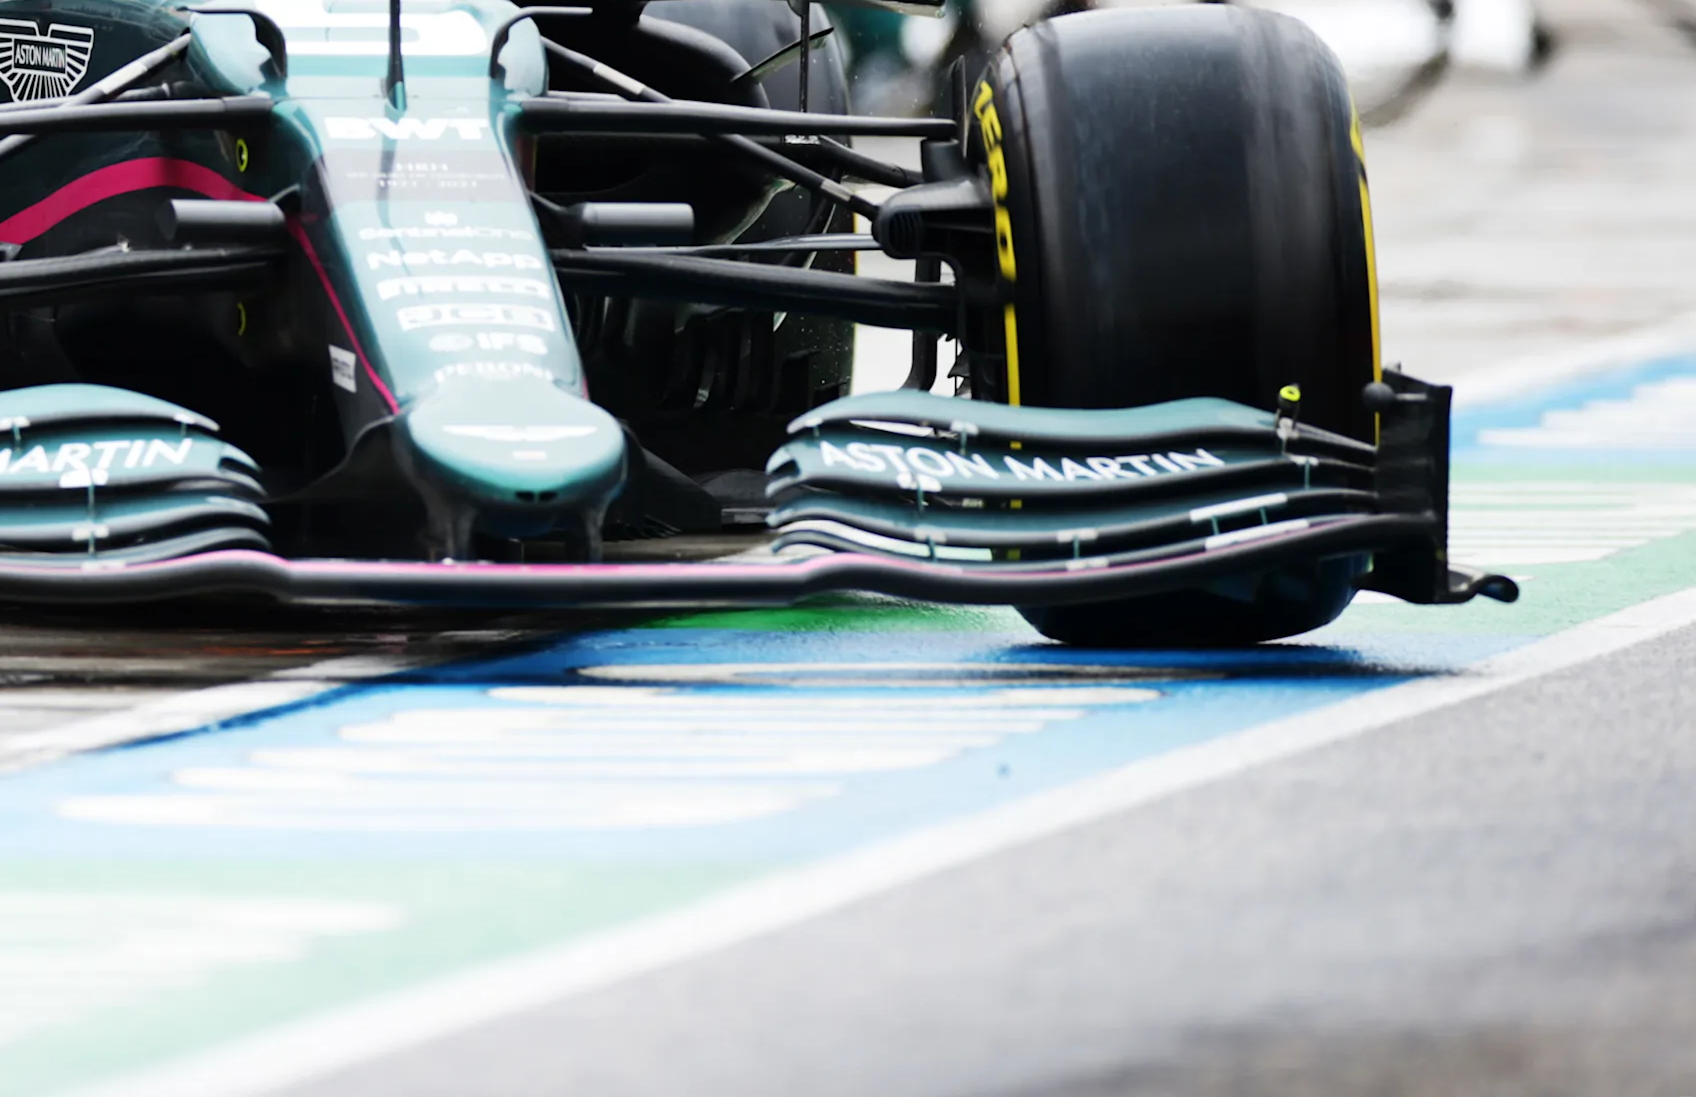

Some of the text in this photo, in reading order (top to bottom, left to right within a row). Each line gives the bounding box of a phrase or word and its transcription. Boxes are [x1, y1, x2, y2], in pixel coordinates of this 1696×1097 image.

[15, 43, 65, 69] ASTON MARTIN
[324, 116, 488, 140] BWT
[365, 249, 542, 270] NetApp
[820, 441, 1225, 482] ASTON MARTIN
